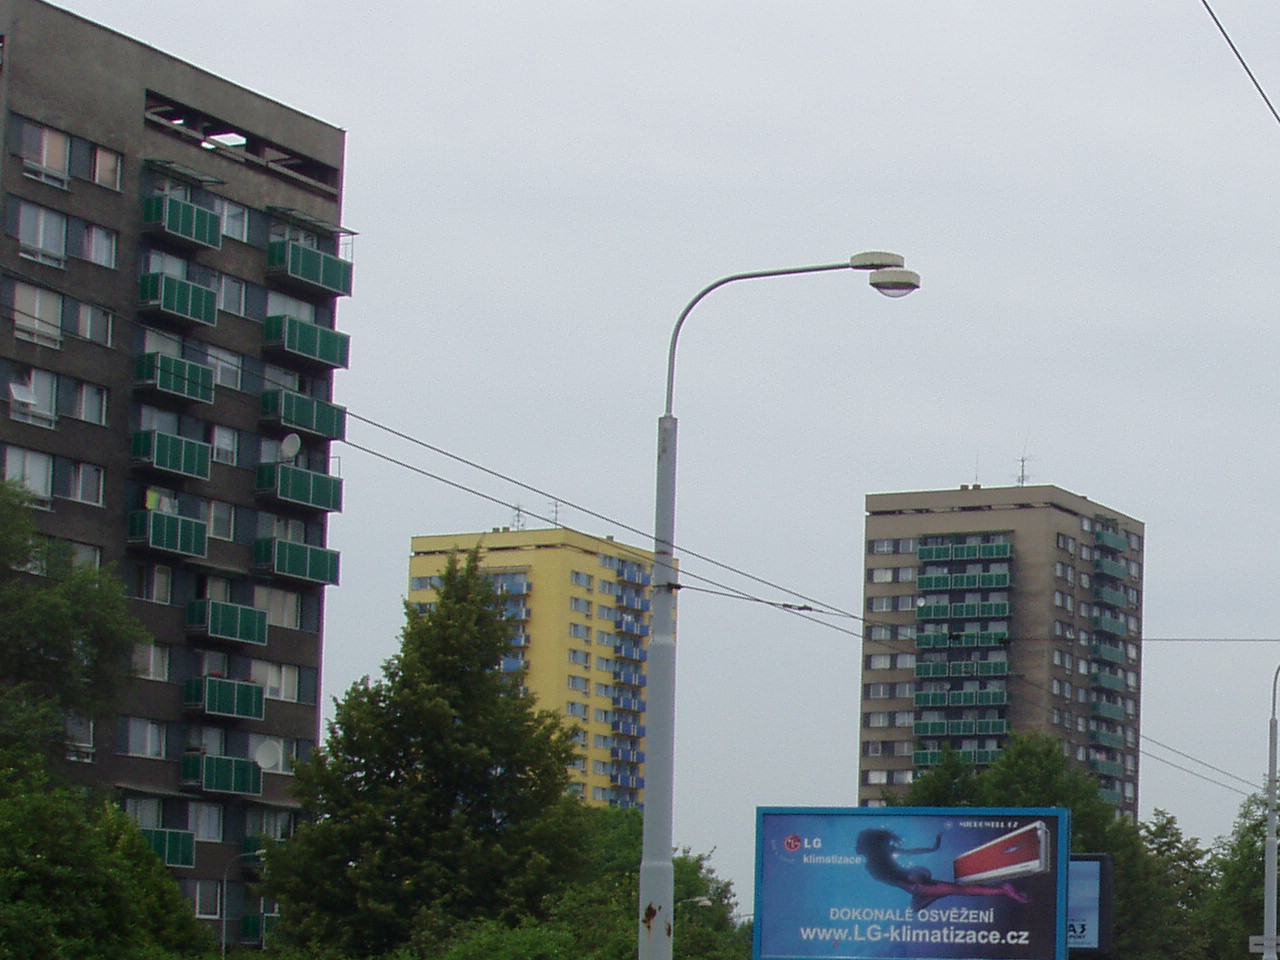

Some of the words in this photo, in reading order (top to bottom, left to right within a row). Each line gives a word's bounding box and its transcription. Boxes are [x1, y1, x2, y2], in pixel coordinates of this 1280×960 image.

[804, 838, 822, 849] LG
[803, 854, 861, 864] klimatizace
[829, 906, 913, 922] DOKONALÉ
[917, 907, 995, 924] OSVĚŽENÍ
[800, 924, 1030, 945] www.LG-klimatizace.cz
